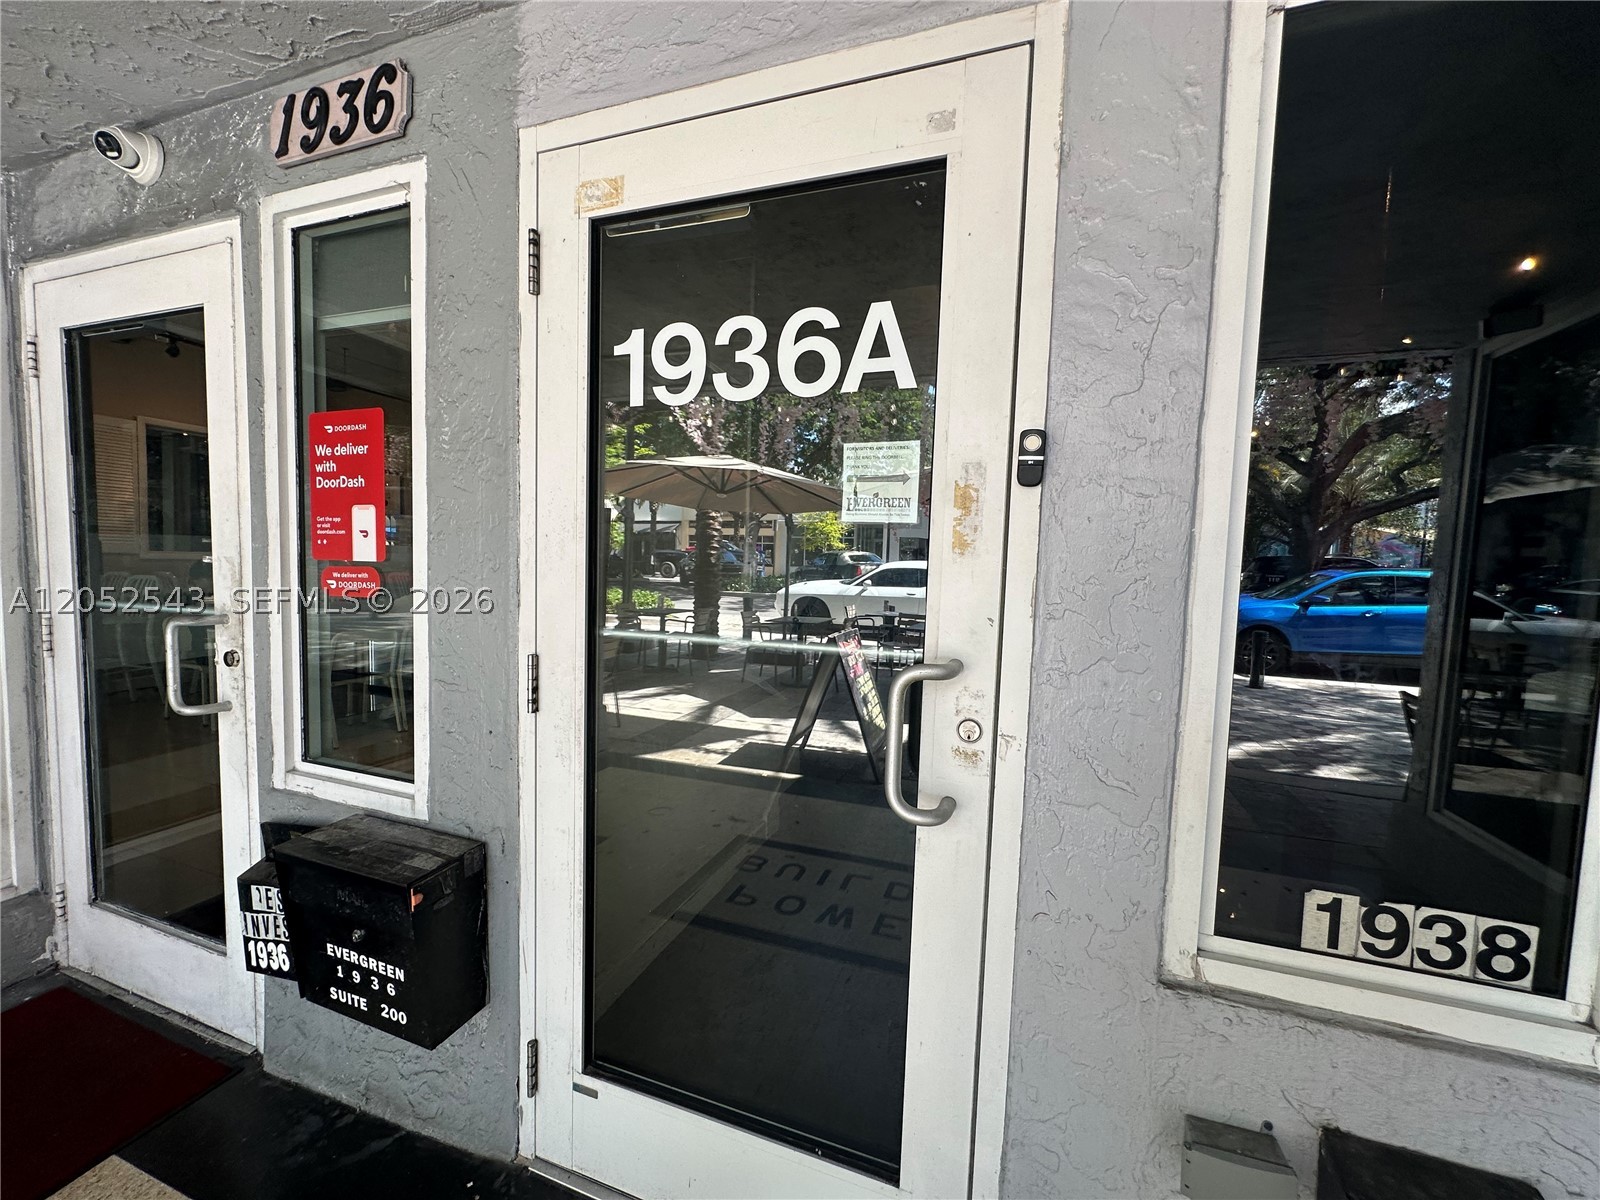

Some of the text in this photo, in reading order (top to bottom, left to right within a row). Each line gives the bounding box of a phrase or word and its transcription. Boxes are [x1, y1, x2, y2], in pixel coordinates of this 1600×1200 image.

[274, 62, 398, 160] 1936
[613, 300, 918, 408] 1936A
[334, 424, 367, 432] DOORDASH
[315, 443, 368, 457] We deliver
[315, 460, 337, 472] with
[316, 475, 365, 489] DoorDash
[846, 497, 911, 512] EVERGREEN
[338, 581, 376, 589] DOORDASH
[1316, 896, 1532, 982] 1938
[248, 939, 291, 972] 1936
[326, 943, 405, 983] EVERGREEN
[329, 986, 408, 1025] SUITE 200
